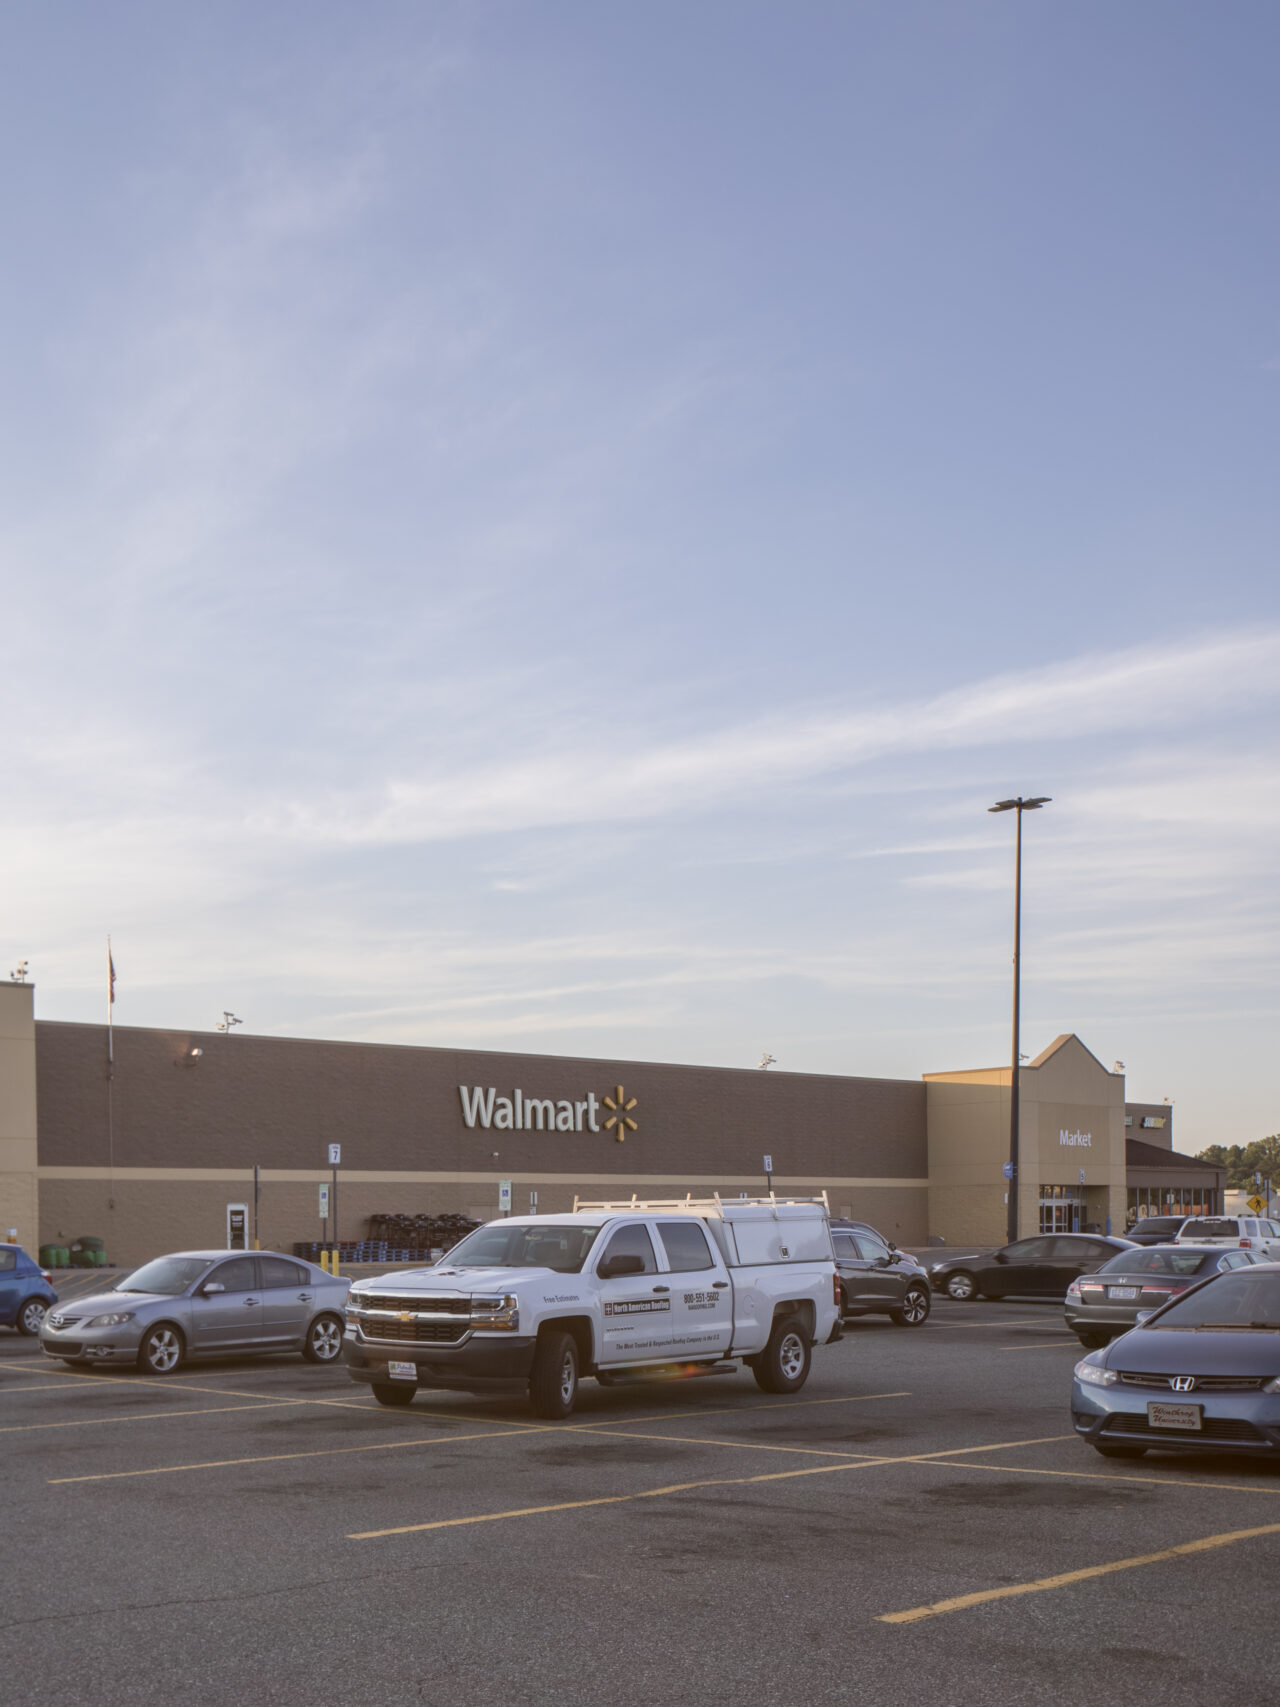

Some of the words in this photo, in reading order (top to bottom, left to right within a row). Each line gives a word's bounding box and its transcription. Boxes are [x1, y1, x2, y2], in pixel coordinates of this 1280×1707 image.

[459, 1085, 600, 1132] Walmart
[1060, 1129, 1092, 1147] Market
[333, 1151, 338, 1161] 7
[613, 1304, 627, 1312] North
[628, 1302, 651, 1312] American
[651, 1301, 669, 1311] Roofing
[1152, 1406, 1194, 1417] Winthrop
